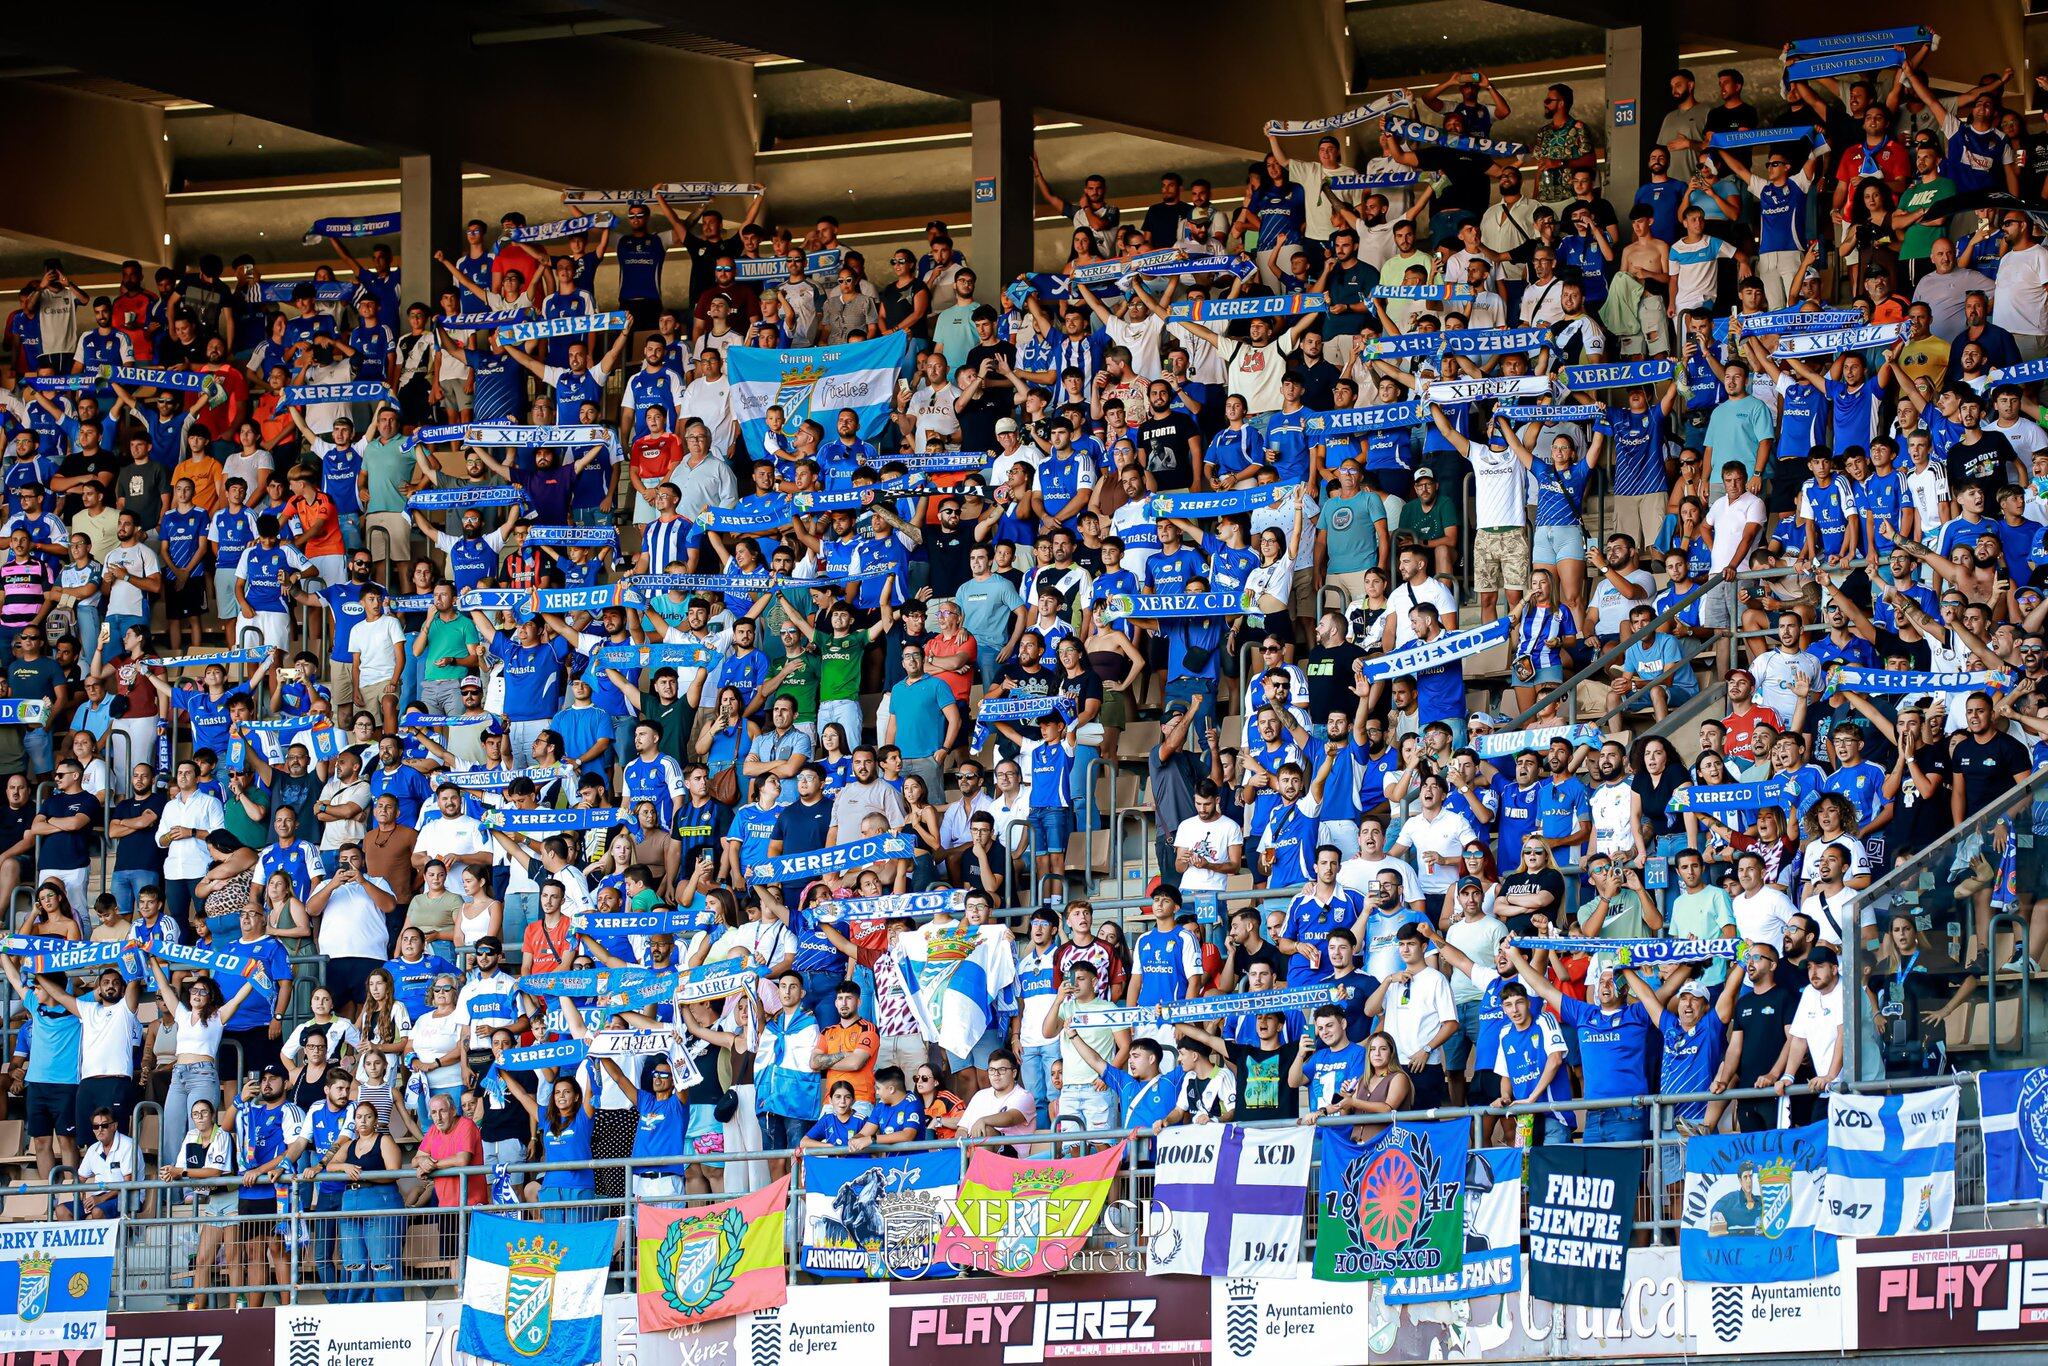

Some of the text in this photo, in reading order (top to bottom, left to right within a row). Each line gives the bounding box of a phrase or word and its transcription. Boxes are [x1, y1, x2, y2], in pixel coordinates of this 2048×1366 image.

[1819, 32, 1895, 47] ETERNO FRESNEDA
[1810, 55, 1885, 73] ETERNO FRESNEDA
[1615, 110, 1633, 123] 313
[1390, 118, 1521, 154] XCD 1947
[1726, 127, 1794, 143] ETERNO FRESNEDA
[679, 183, 738, 193] XEREZ
[1909, 190, 1938, 207] NIKE
[519, 216, 588, 239] XEREZ CD
[1142, 253, 1173, 267] XEREZ
[1191, 256, 1229, 267] AZULINO
[1080, 266, 1112, 277] XEREZ
[1419, 285, 1438, 297] CD
[1208, 298, 1286, 318] XEREZ CD
[518, 314, 609, 339] XEREZ
[1775, 315, 1801, 326] CLUB
[1449, 336, 1475, 353] CD
[1477, 331, 1540, 352] XEREZ
[1809, 326, 1883, 350] XEREZ
[291, 385, 353, 401] XEREZ
[356, 383, 383, 397] CD
[1449, 379, 1521, 399] XEREZ
[1331, 406, 1411, 429] XEREZ CD
[1513, 406, 1543, 418] CLUB
[498, 428, 576, 443] XEREZ
[1151, 426, 1177, 439] TORTA
[441, 490, 469, 502] CLUB
[818, 492, 859, 504] XEREZ
[1178, 497, 1238, 511] XEREZ CD
[1251, 496, 1268, 506] 1947
[720, 513, 771, 525] XEREZ CD
[549, 528, 574, 540] CLUB
[631, 574, 768, 588] XEREZ CLUB DEPORTIVO
[545, 589, 608, 609] XEREZ CD
[343, 605, 364, 613] LUGO
[989, 700, 1015, 713] CLUB
[194, 714, 227, 726] Canasta
[1486, 729, 1525, 755] FORZA
[1695, 788, 1752, 804] XEREZ CD
[1764, 789, 1782, 798] 1947
[512, 813, 577, 826] XEREZ CD
[591, 815, 611, 823] 1947
[781, 841, 877, 876] XEREZ CD
[1647, 870, 1665, 884] 211
[847, 889, 944, 916] XEREZ CD
[1197, 905, 1214, 920] 212
[594, 915, 659, 929] XEREZ CD
[672, 918, 690, 927] 1947
[51, 942, 121, 969] XEREZ CD
[159, 941, 240, 971] XEREZ CD
[1671, 938, 1741, 958] XEREZ
[696, 977, 736, 996] XEREZ
[1170, 1004, 1214, 1017] XEREZ
[1216, 998, 1250, 1012] CLUB
[1252, 990, 1329, 1008] DEPORTIVO
[610, 1035, 670, 1052] XEREZ
[1582, 1030, 1621, 1043] Canasta
[511, 1044, 576, 1063] XEREZ CD
[1834, 1108, 1874, 1129] XCD
[1156, 1143, 1297, 1166] HOOLS XCD
[1325, 1181, 1463, 1220] 19 47
[1544, 1173, 1616, 1212] FABIO
[1828, 1199, 1873, 1221] 1947
[1528, 1205, 1623, 1244] SIEMPRE
[42, 1226, 109, 1249] FAMILY
[1243, 1241, 1288, 1264] 1947
[1460, 1257, 1514, 1289] FANS
[1751, 1284, 1842, 1304] Ayuntamiento
[1878, 1263, 1999, 1313] PLAY
[941, 1290, 1029, 1305] ENTRENA, JUEGA,
[1265, 1303, 1354, 1321] Ayuntamiento
[1751, 1303, 1802, 1322] de Jerez
[62, 1321, 98, 1340] 1947
[789, 1321, 876, 1339] Ayuntamiento
[909, 1299, 1158, 1365] PLAY JEREZ
[1265, 1322, 1316, 1339] de Jerez
[327, 1337, 413, 1355] Ayuntamiento
[679, 1337, 730, 1366] Xerez
[789, 1339, 838, 1355] de Jerez
